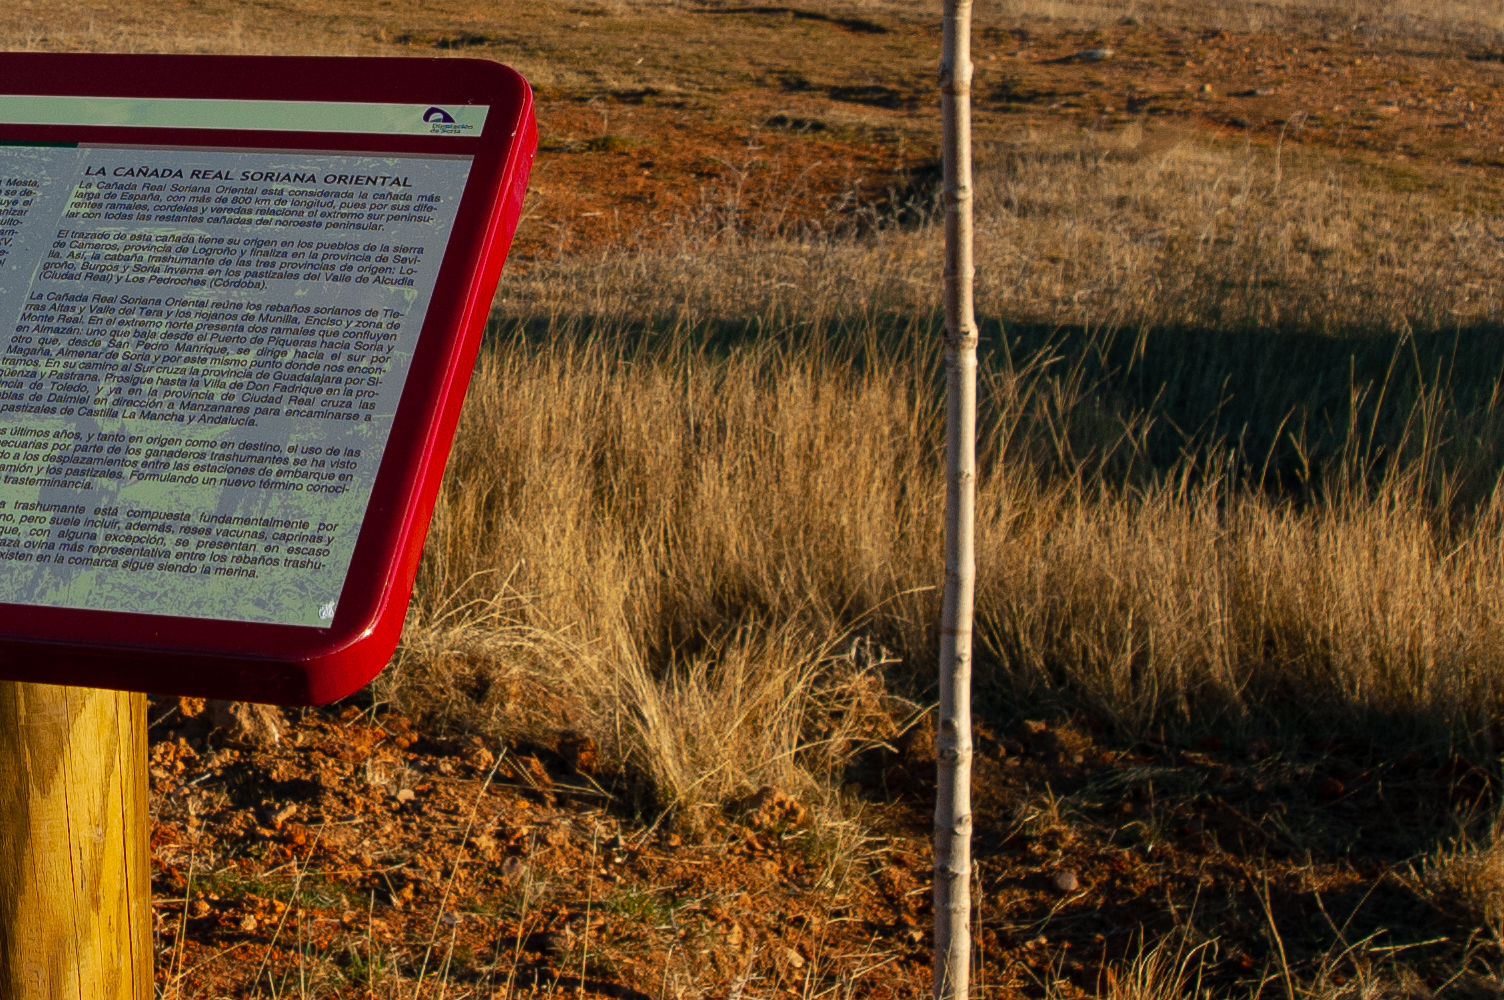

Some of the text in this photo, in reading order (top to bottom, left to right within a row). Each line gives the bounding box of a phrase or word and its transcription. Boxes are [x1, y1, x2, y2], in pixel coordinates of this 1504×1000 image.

[6, 178, 40, 189] Mesta,
[84, 165, 411, 187] LA CAÑADA REAL SORIANA ORIENTAL
[78, 180, 93, 191] La
[96, 181, 137, 191] Cañada
[141, 183, 167, 191] Real
[169, 184, 211, 194] Soriana
[215, 185, 259, 195] Oriental
[261, 187, 285, 196] está
[358, 191, 369, 200] la
[372, 191, 412, 202] cañada
[416, 193, 441, 202] más
[38, 271, 83, 281] (Ciudad
[83, 272, 114, 284] Real)
[114, 274, 124, 285] y
[124, 274, 145, 284] Los
[29, 291, 405, 319] La Cañada Real Soriana Oriental reúne los rebaños sorianos de Tie-
[9, 426, 51, 438] últimos
[52, 429, 83, 441] años,
[85, 433, 95, 442] y
[97, 432, 126, 443] tanto
[128, 435, 144, 444] en
[145, 434, 183, 447] origen
[184, 438, 218, 449] como
[220, 441, 236, 450] en
[238, 440, 283, 454] destino,
[287, 443, 299, 454] el
[300, 446, 323, 455] uso
[325, 446, 340, 457] de
[343, 446, 361, 458] las
[93, 506, 119, 517] está
[316, 520, 340, 532] por
